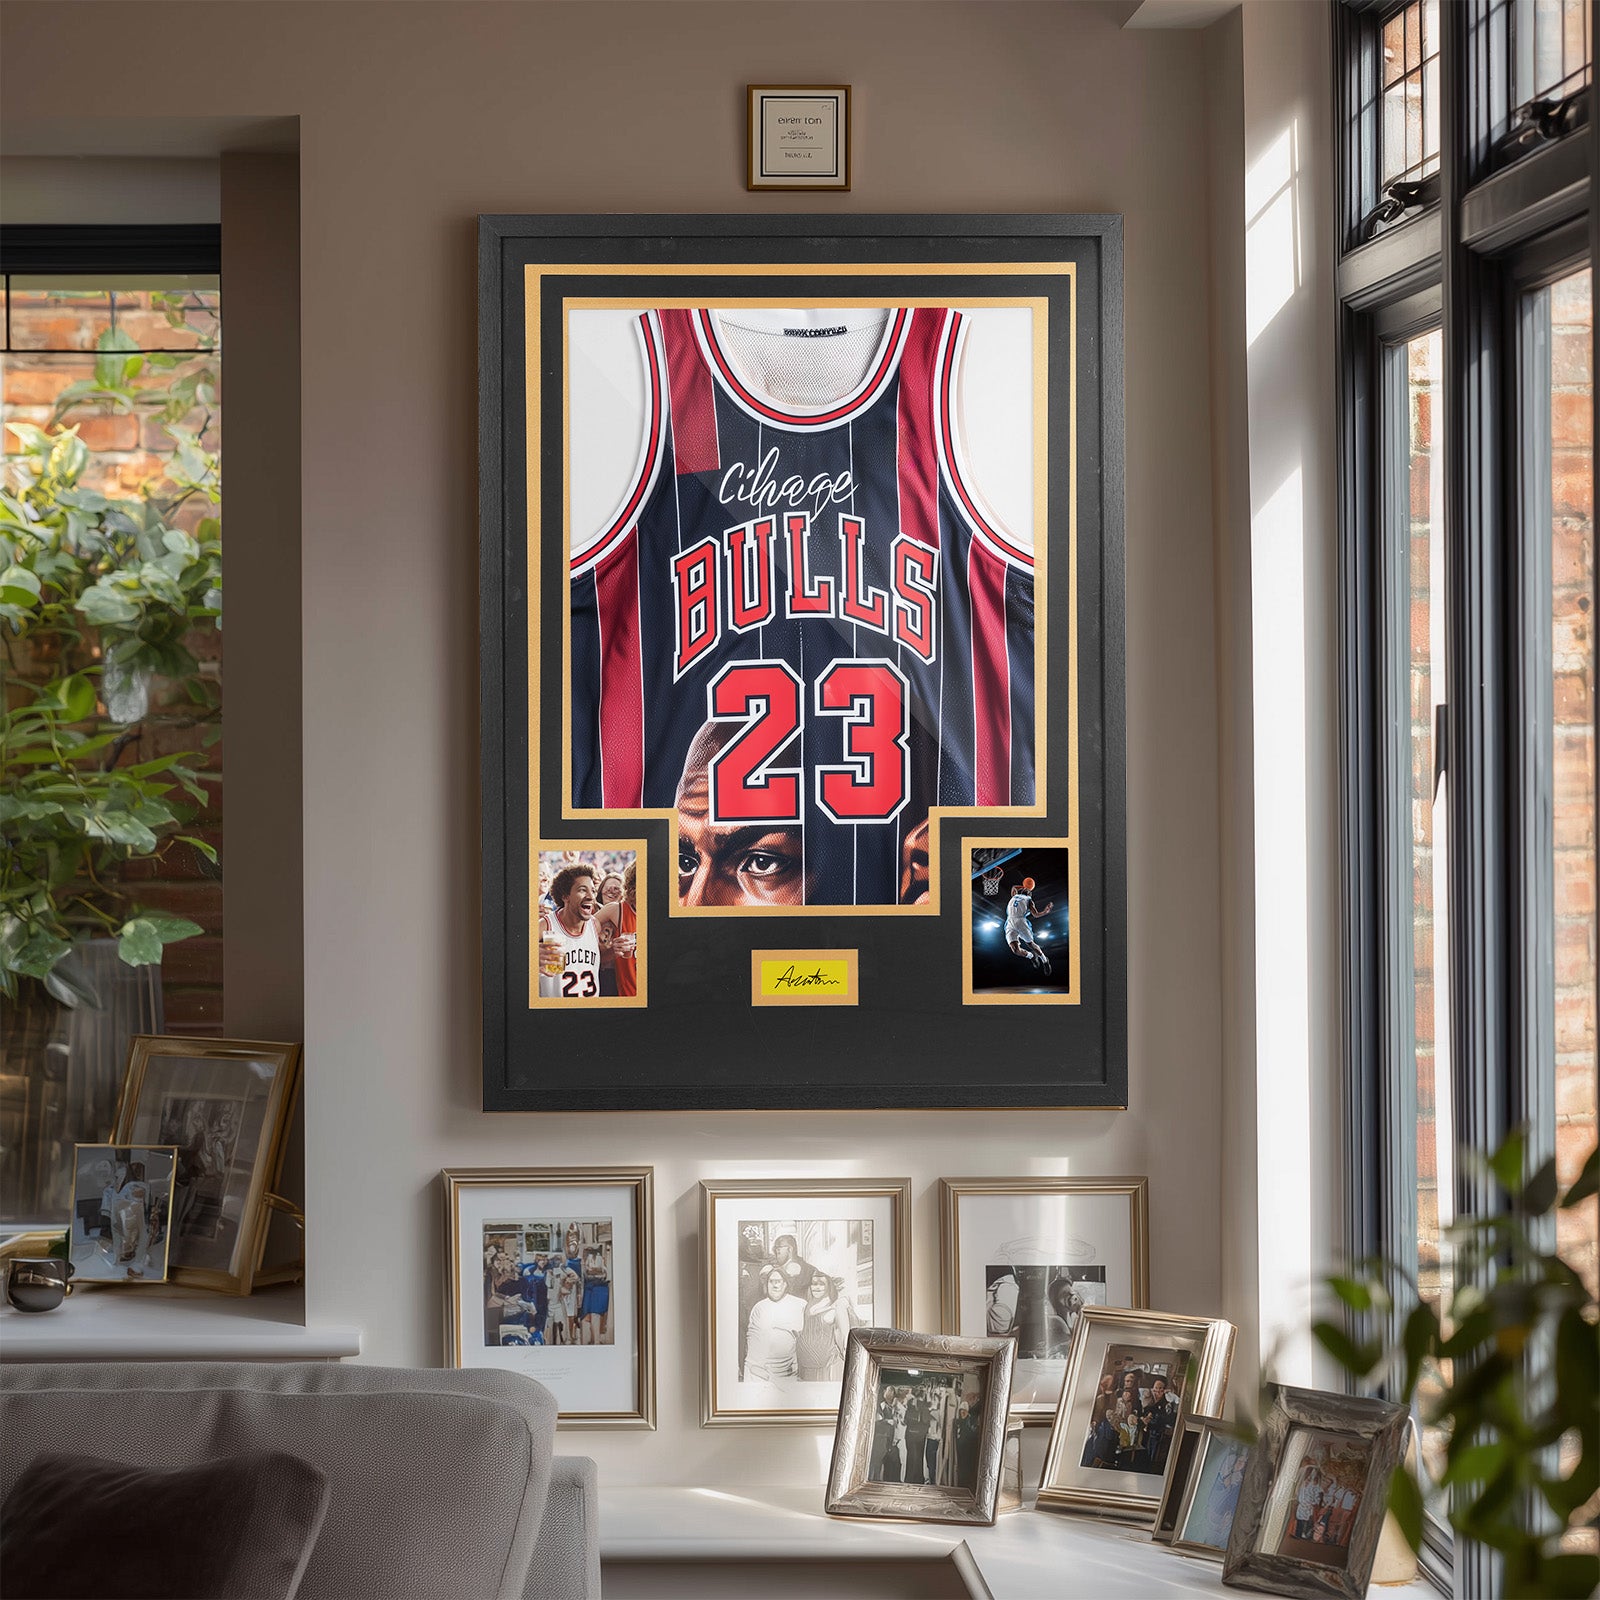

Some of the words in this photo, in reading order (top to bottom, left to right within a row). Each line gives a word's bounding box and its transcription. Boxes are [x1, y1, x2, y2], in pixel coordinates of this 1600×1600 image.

[670, 511, 939, 684] BULLS
[707, 658, 911, 825] 23
[562, 970, 597, 998] 23
